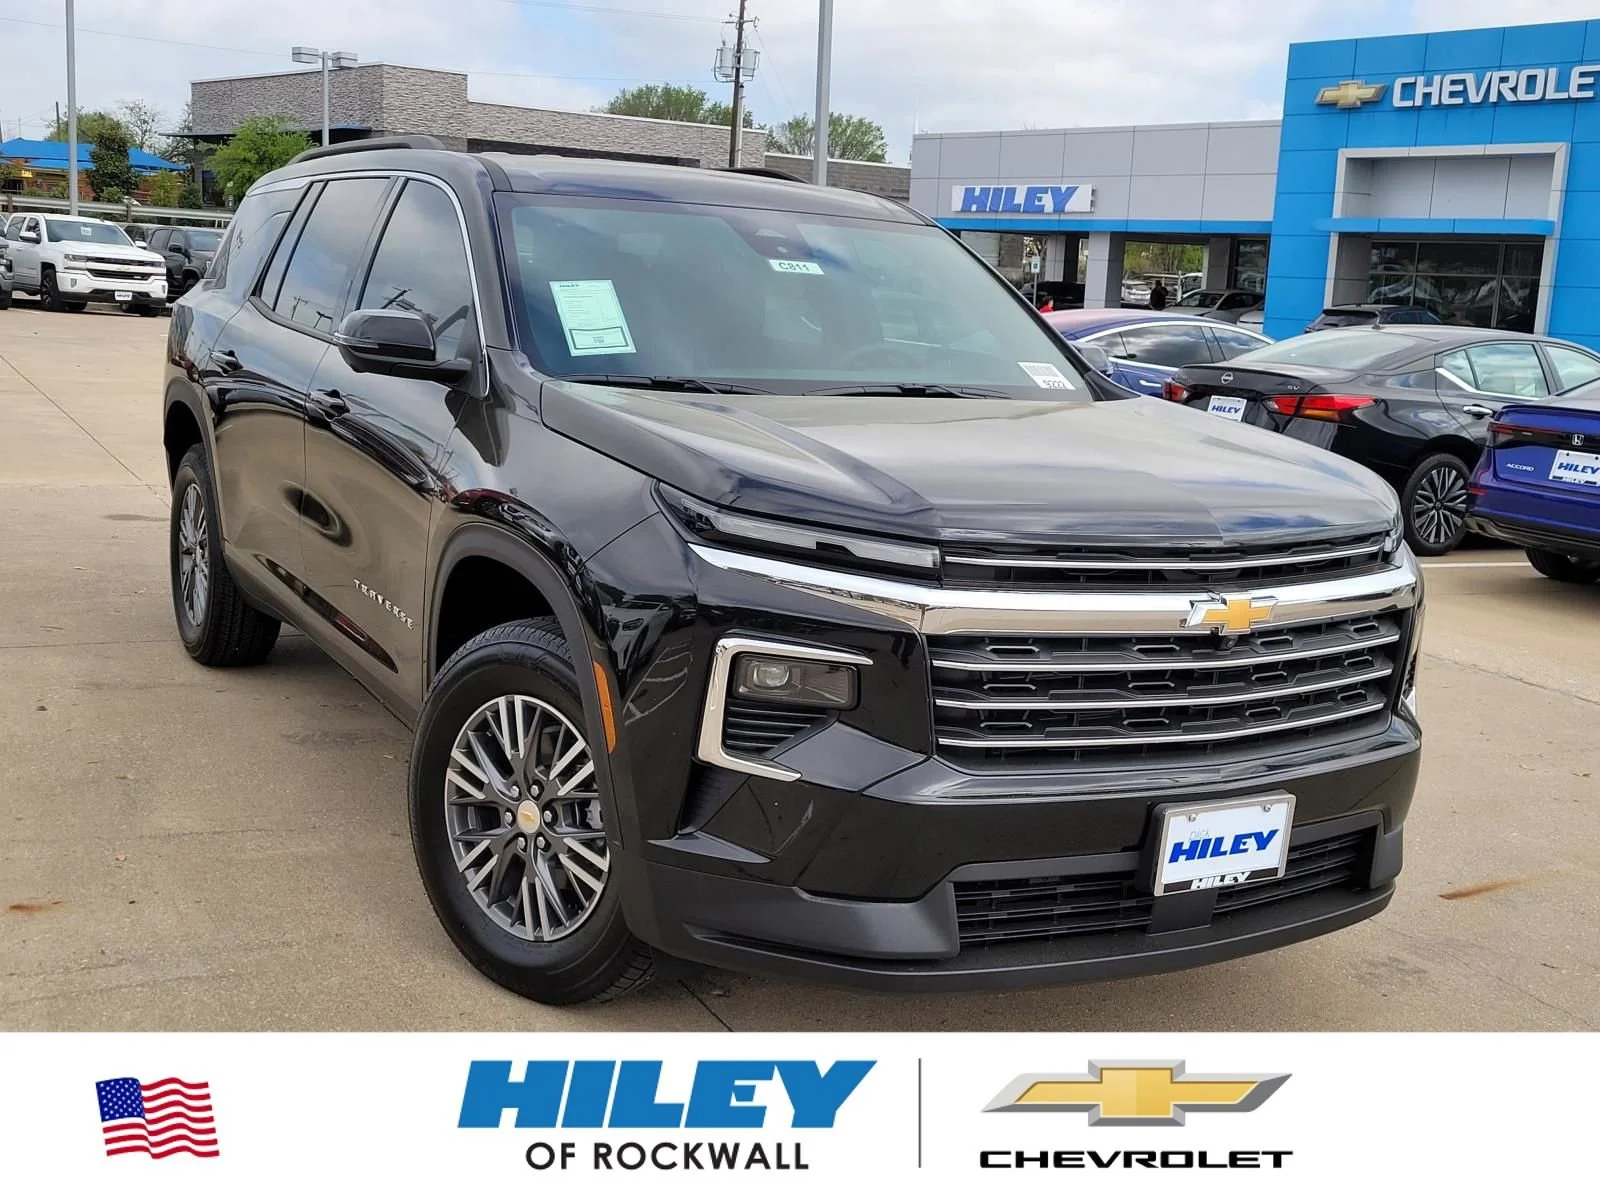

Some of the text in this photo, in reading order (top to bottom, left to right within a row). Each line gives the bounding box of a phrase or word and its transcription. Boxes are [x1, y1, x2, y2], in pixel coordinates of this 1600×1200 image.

[1392, 65, 1600, 108] CHEVROLE
[961, 185, 1079, 213] HILEY
[778, 262, 810, 272] C811
[1211, 404, 1242, 414] HILEY
[1505, 463, 1535, 472] ACCORD
[1557, 462, 1600, 475] HILEY
[353, 578, 415, 631] TRAVERSE
[1168, 829, 1279, 864] HILEY
[1190, 871, 1251, 890] HILEY
